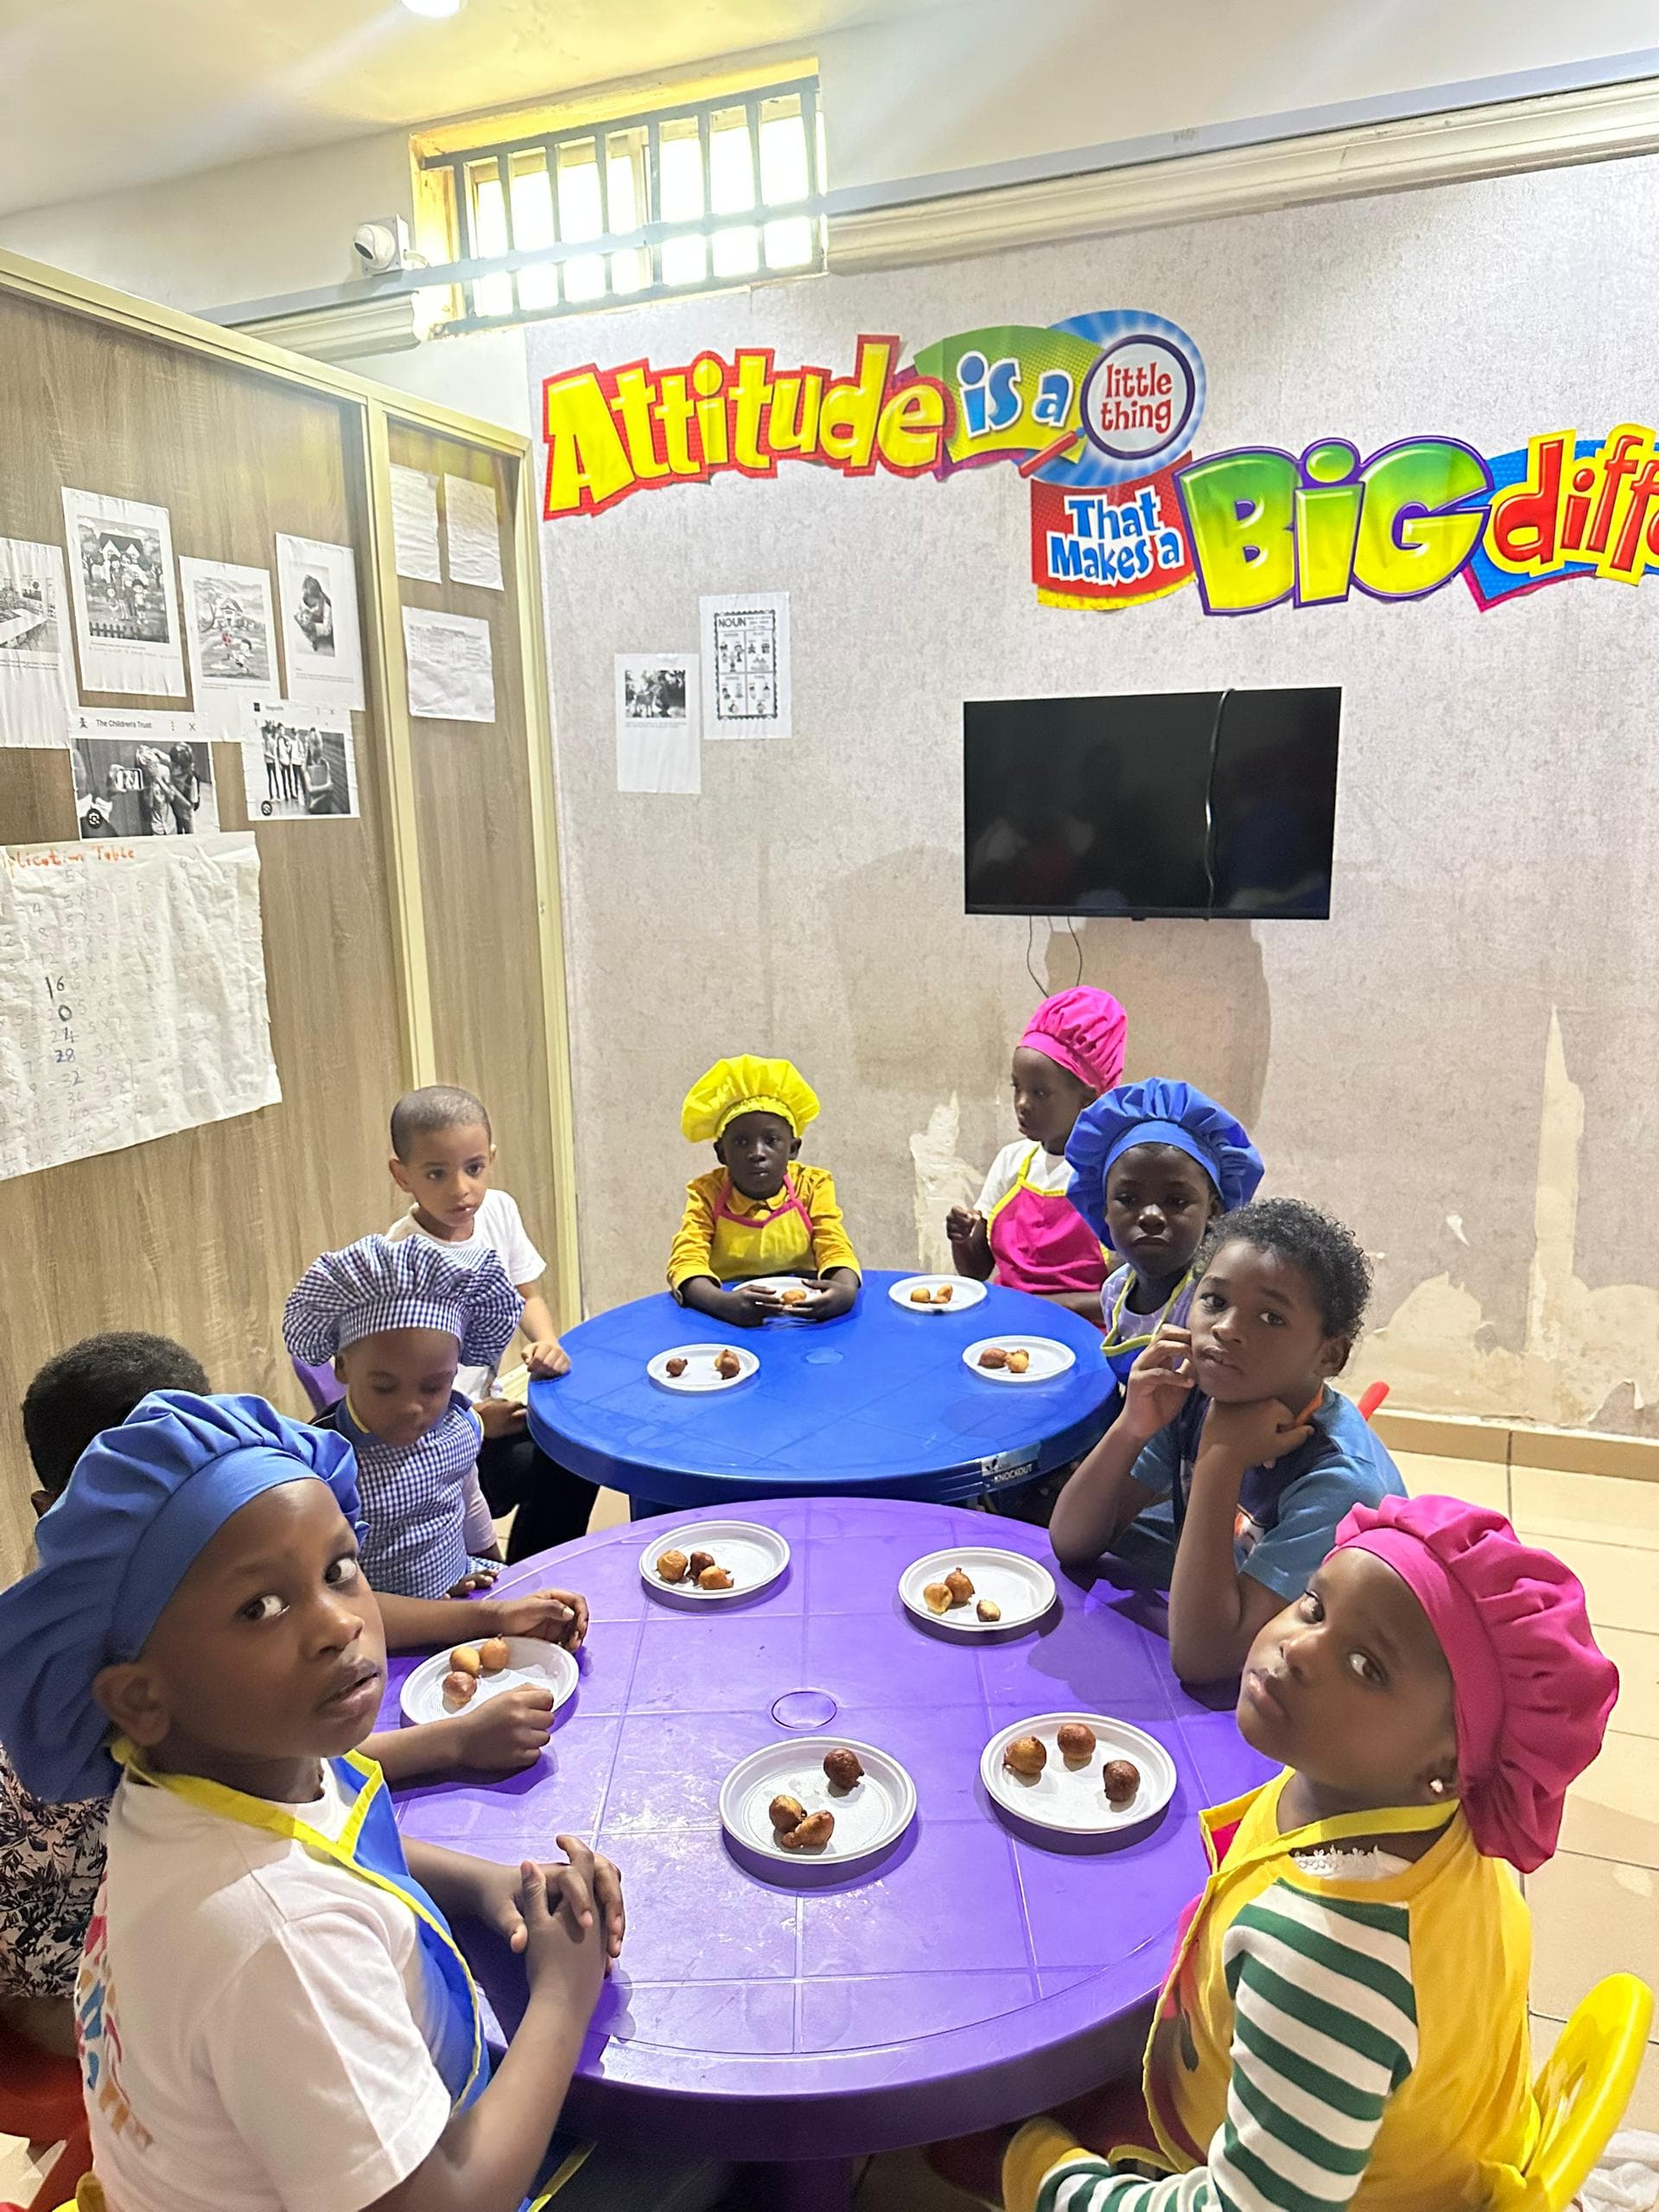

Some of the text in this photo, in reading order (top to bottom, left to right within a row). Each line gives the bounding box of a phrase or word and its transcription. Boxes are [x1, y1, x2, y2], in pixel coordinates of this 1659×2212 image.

[1105, 361, 1173, 398] little
[543, 335, 1073, 517] Attitude is a
[1100, 398, 1173, 435] thing
[1064, 486, 1161, 542] That
[1046, 530, 1184, 586] Makes a
[718, 617, 747, 627] NOUN
[96, 719, 108, 728] The
[94, 845, 136, 862] Table
